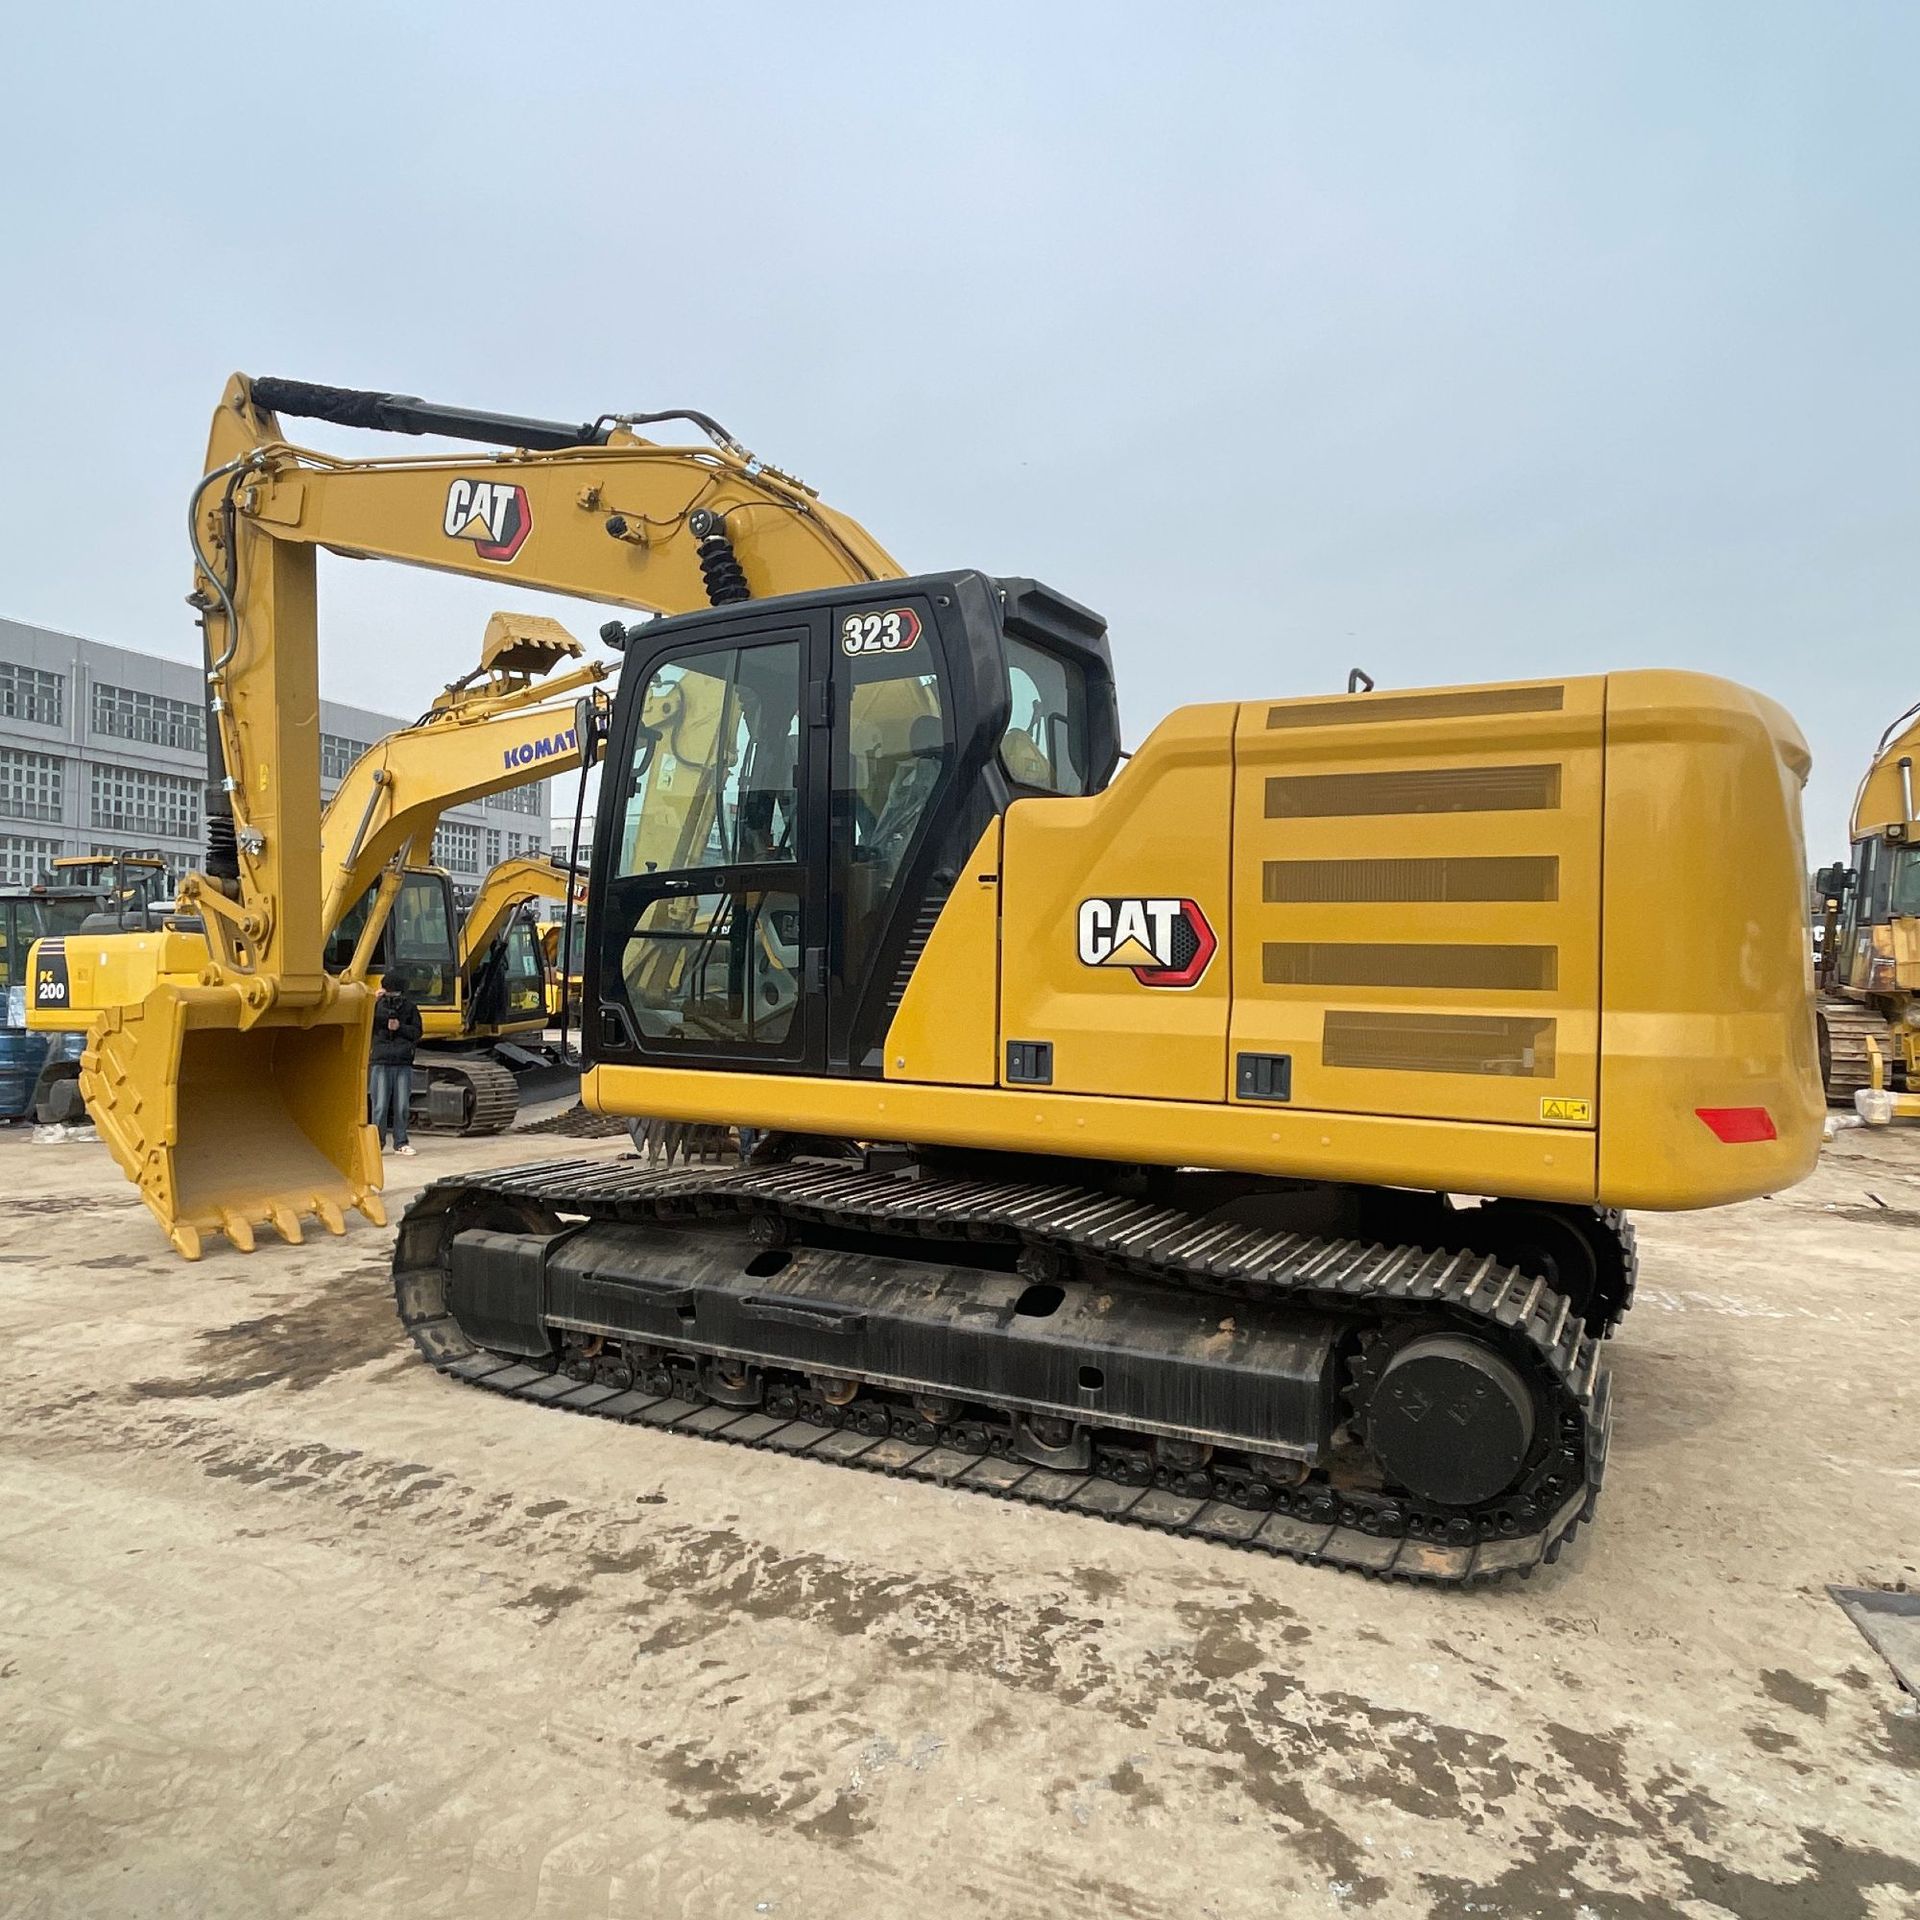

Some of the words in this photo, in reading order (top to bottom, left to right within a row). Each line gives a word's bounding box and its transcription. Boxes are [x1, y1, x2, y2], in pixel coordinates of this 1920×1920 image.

[444, 480, 516, 542] CAT
[845, 613, 901, 652] 323
[504, 729, 577, 769] KOMAT
[1079, 899, 1181, 967] CAT
[39, 982, 65, 999] 200
